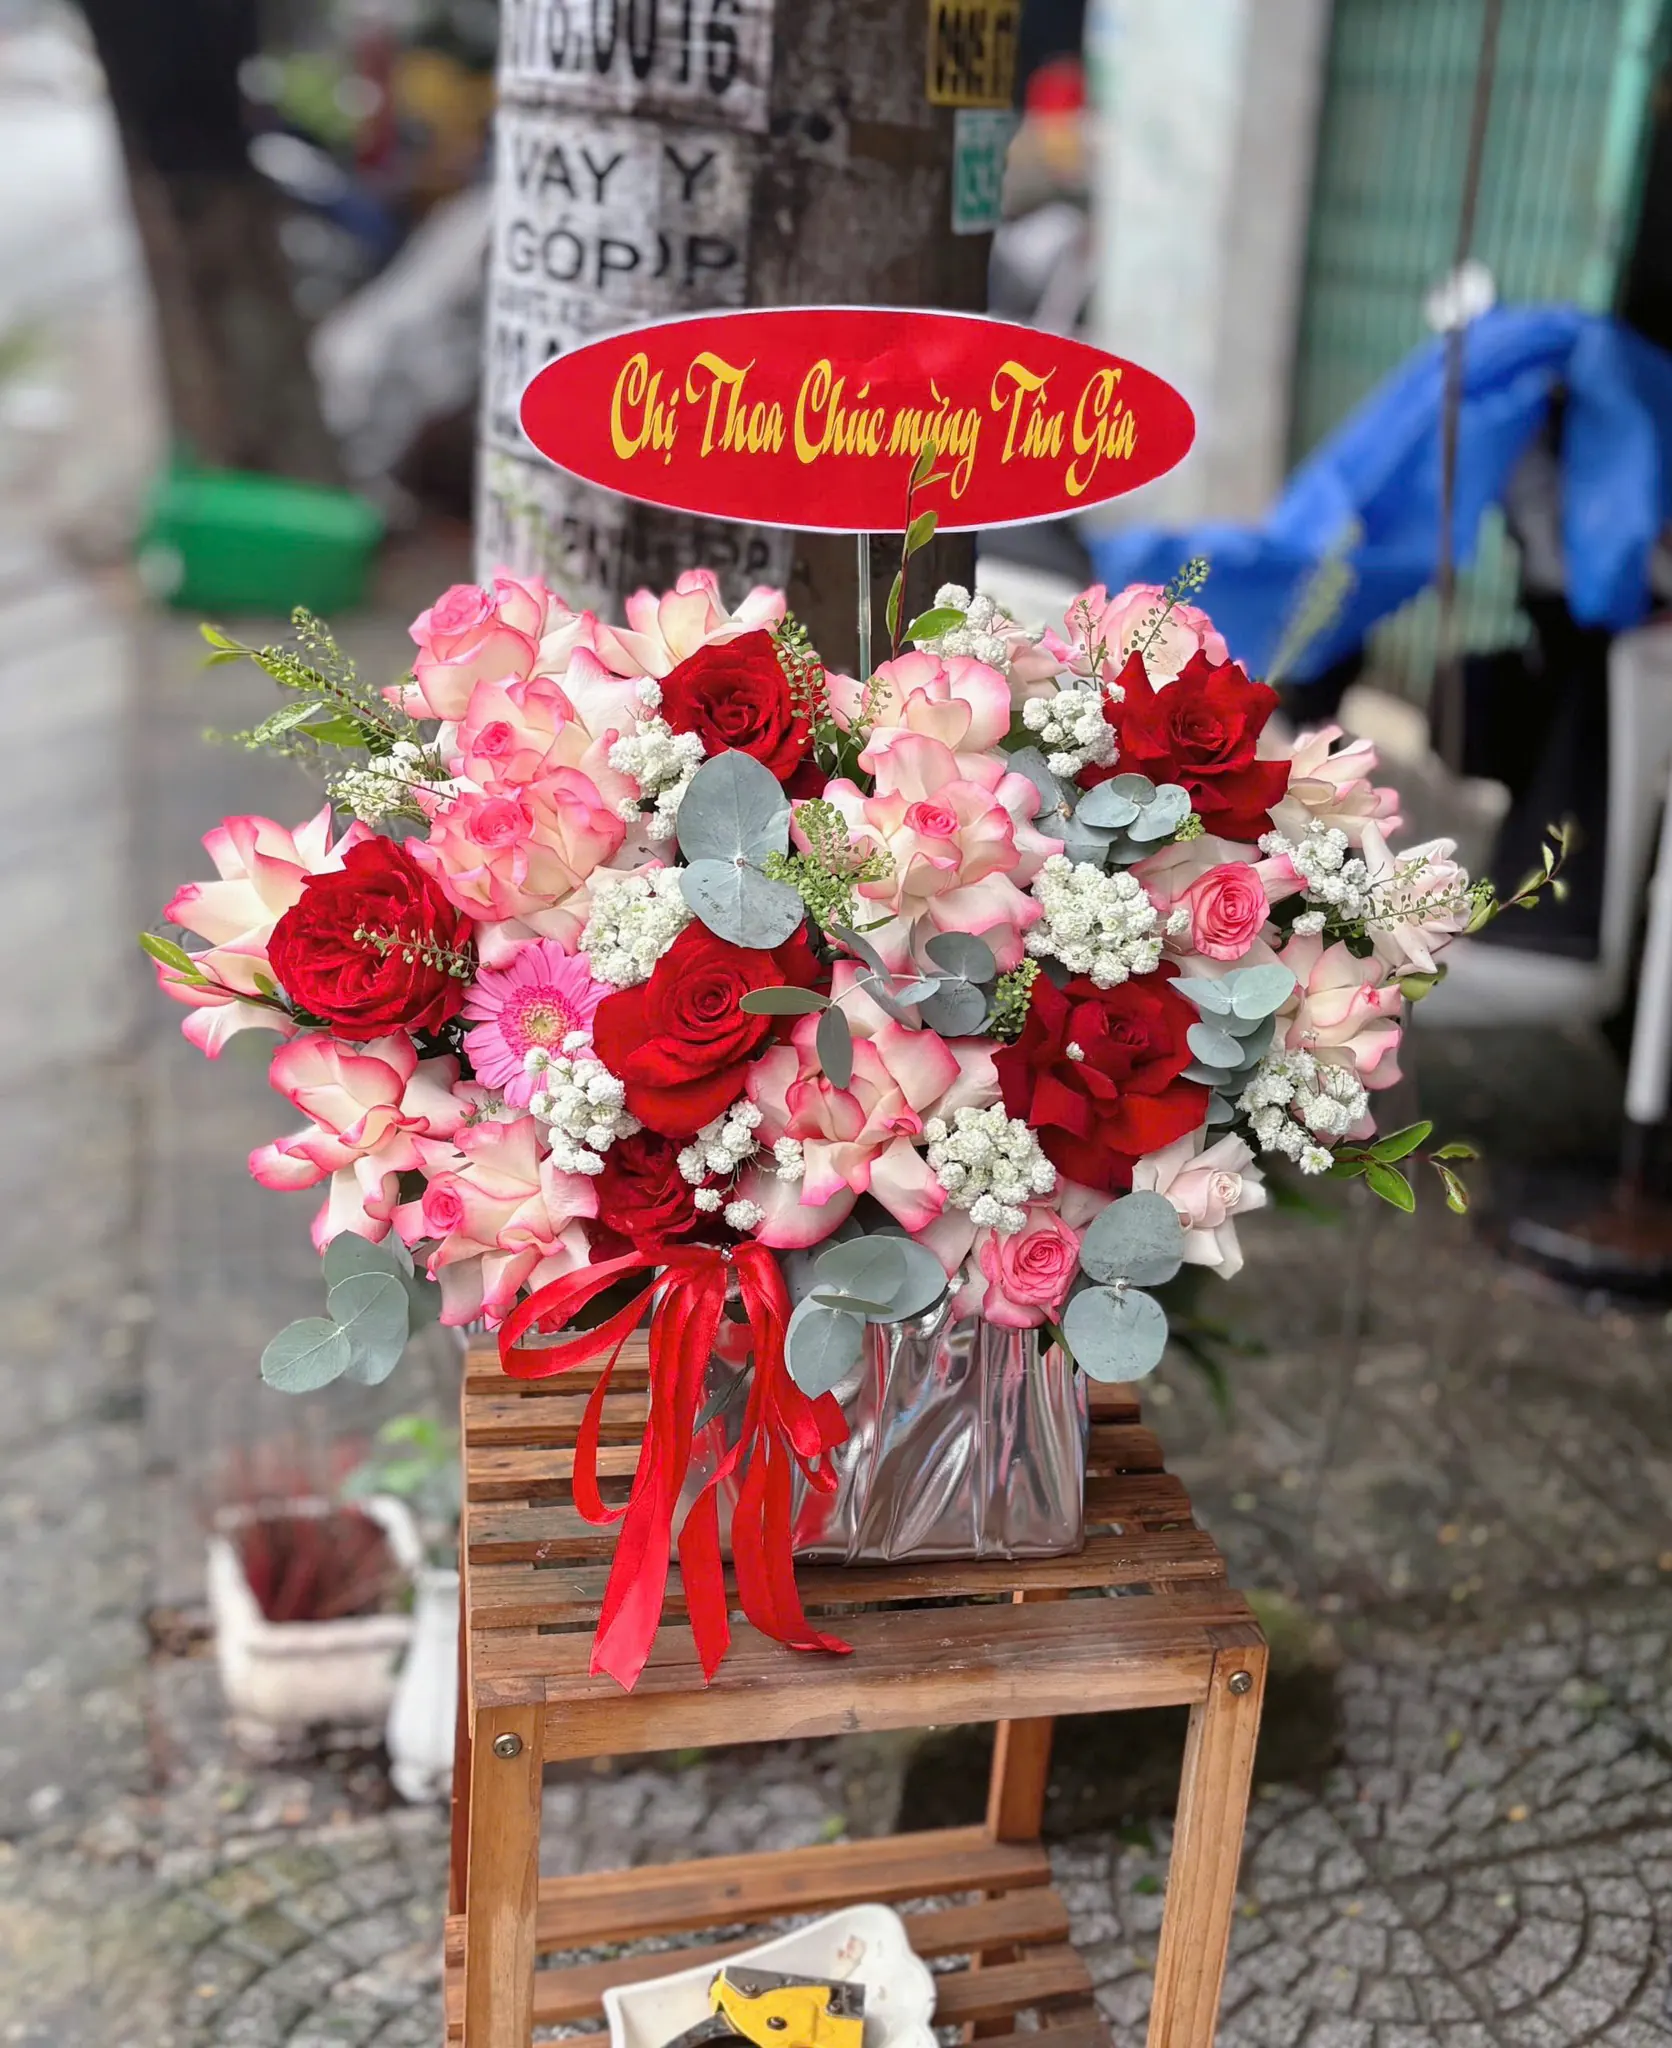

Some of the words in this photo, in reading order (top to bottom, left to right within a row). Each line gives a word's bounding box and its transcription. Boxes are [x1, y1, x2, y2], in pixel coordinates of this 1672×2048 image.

[512, 135, 626, 205] VAY
[611, 352, 680, 466] Chị
[685, 351, 787, 459] Thoa
[794, 358, 886, 465] Chúc
[884, 376, 982, 500] mừng
[990, 360, 1066, 465] Tân
[1065, 368, 1139, 498] Gia
